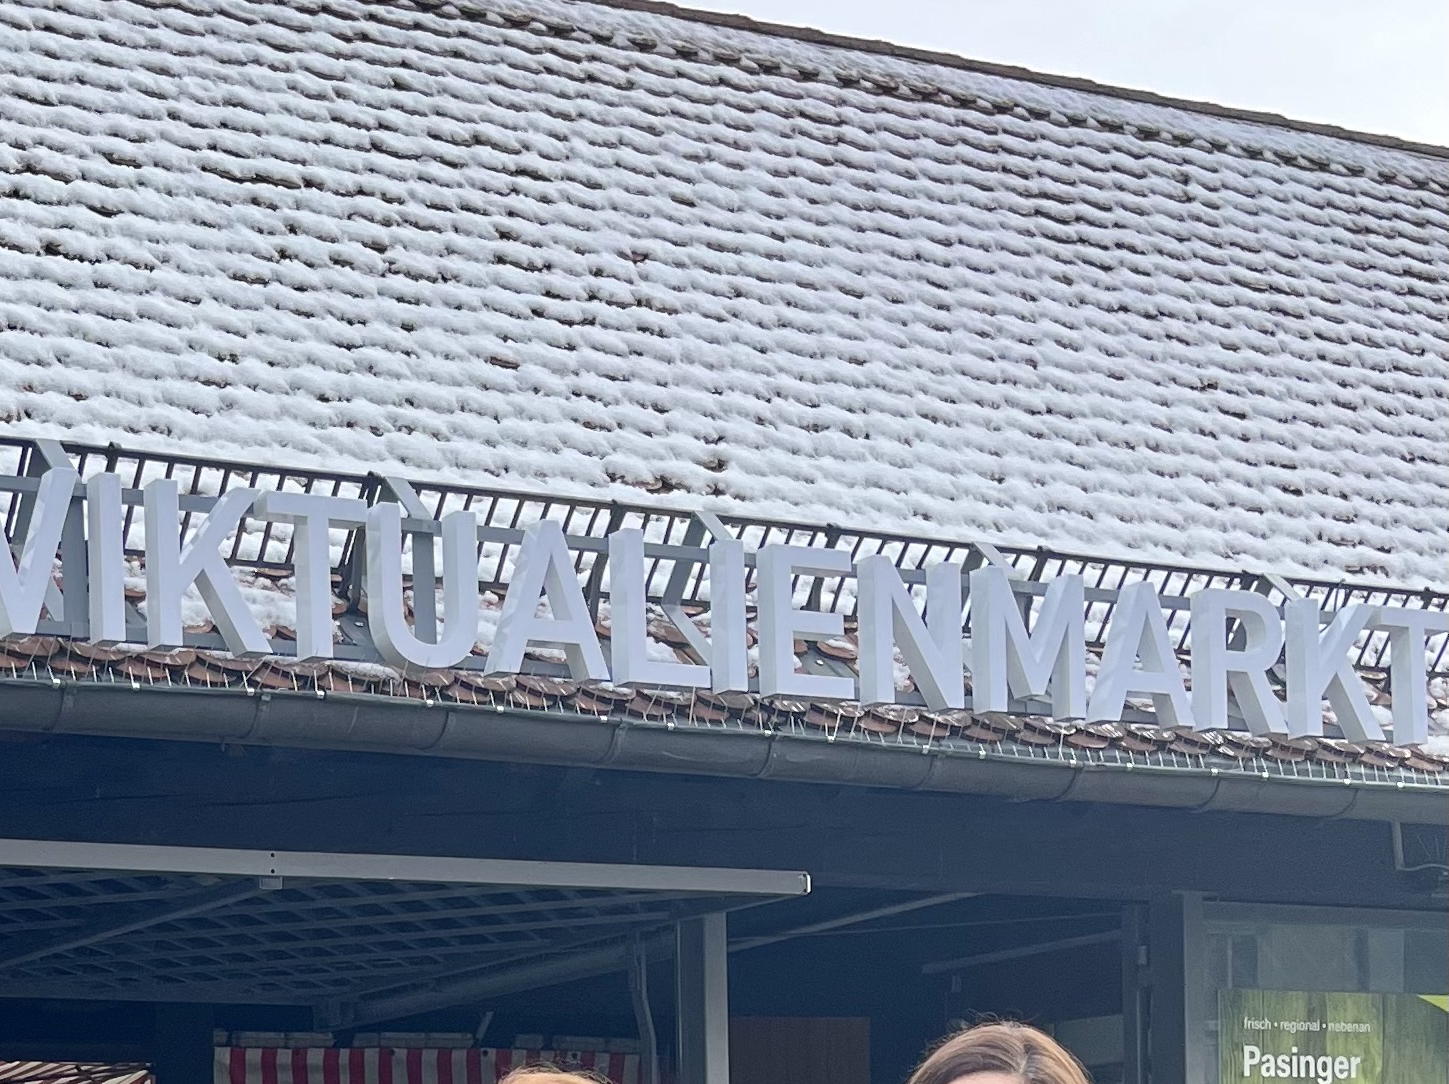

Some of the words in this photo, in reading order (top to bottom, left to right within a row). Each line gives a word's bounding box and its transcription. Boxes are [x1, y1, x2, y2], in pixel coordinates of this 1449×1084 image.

[1243, 1017, 1272, 1031] frisch
[1280, 1019, 1320, 1034] regional
[1328, 1022, 1371, 1033] nebenan
